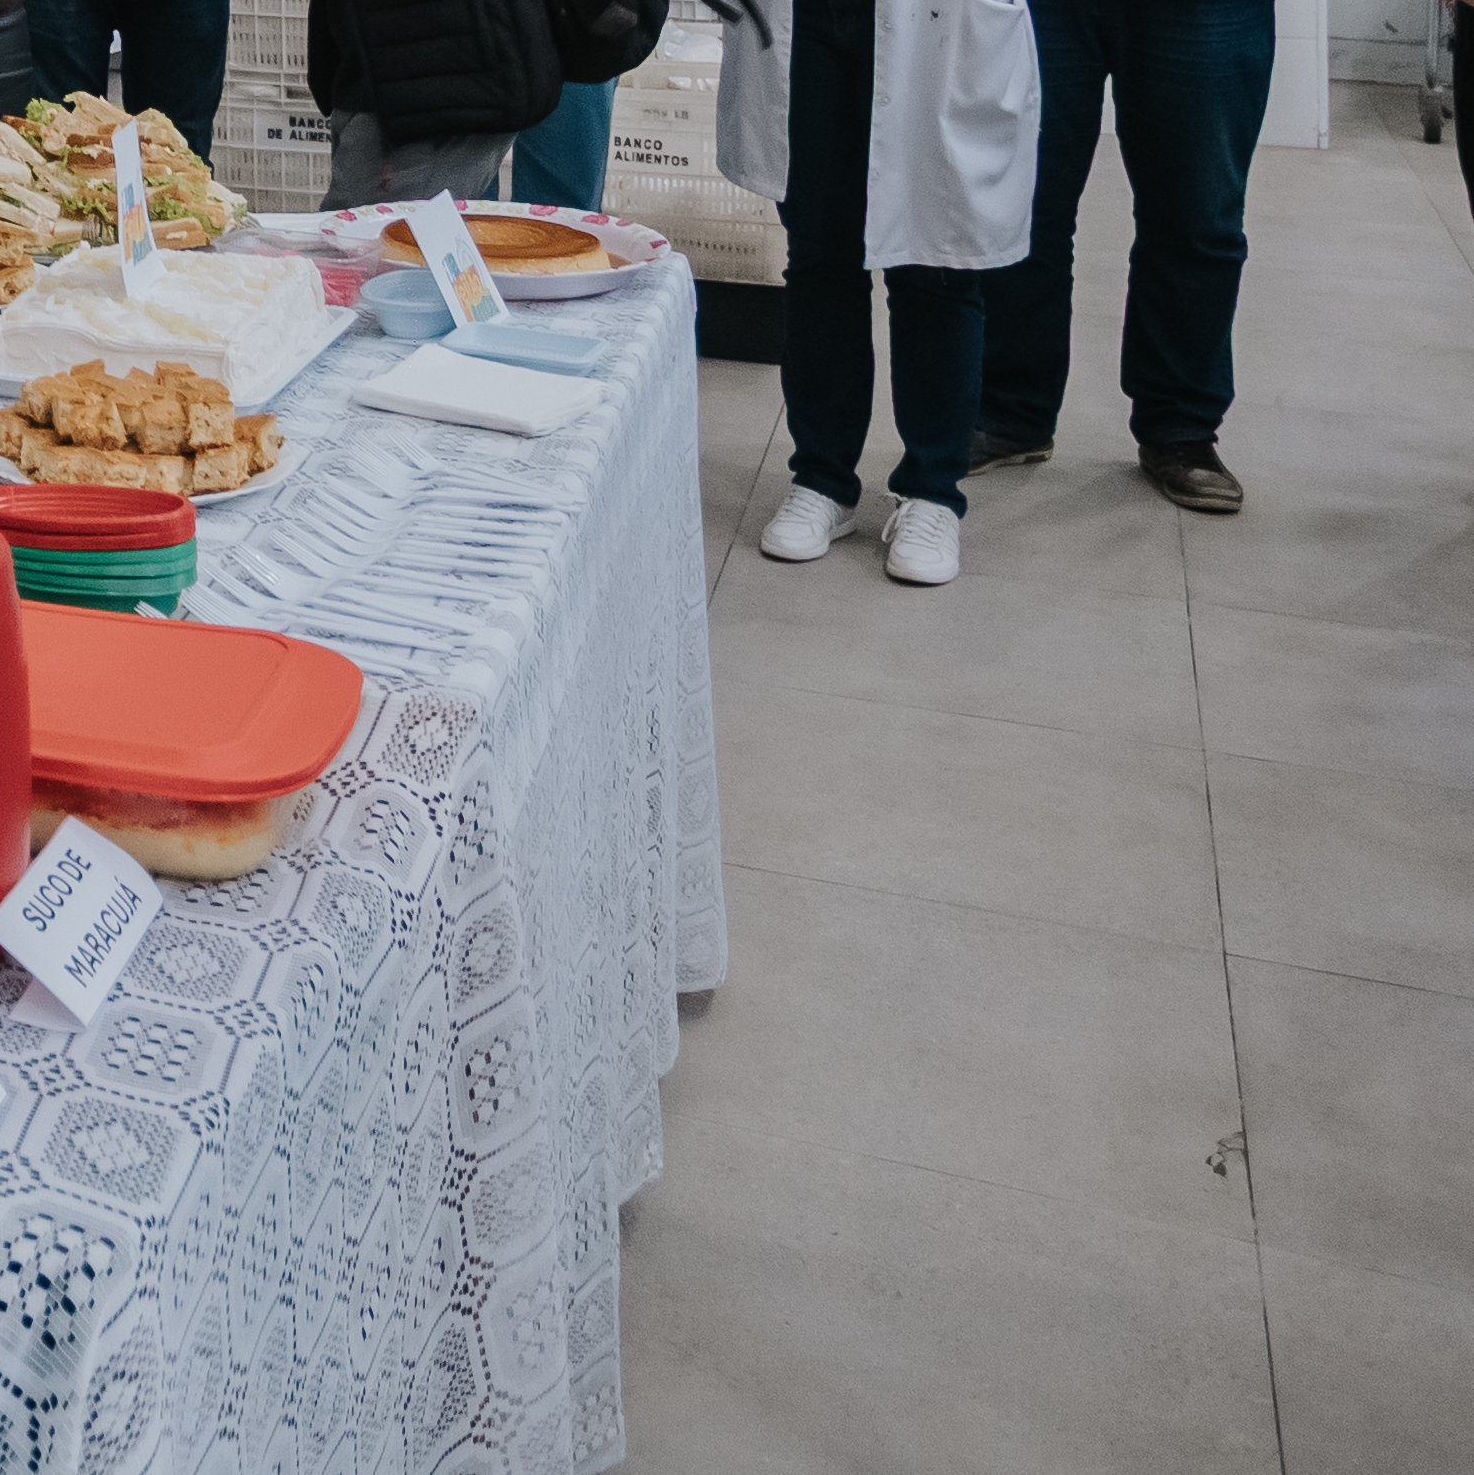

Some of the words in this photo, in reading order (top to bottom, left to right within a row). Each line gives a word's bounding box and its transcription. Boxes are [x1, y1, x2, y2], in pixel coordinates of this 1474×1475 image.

[267, 128, 283, 140] DE
[614, 136, 663, 151] BANCO
[614, 150, 689, 167] ALIMENTOS
[22, 874, 73, 933] SUCO
[56, 848, 93, 883] DE
[63, 875, 143, 989] MARACUJÁ
